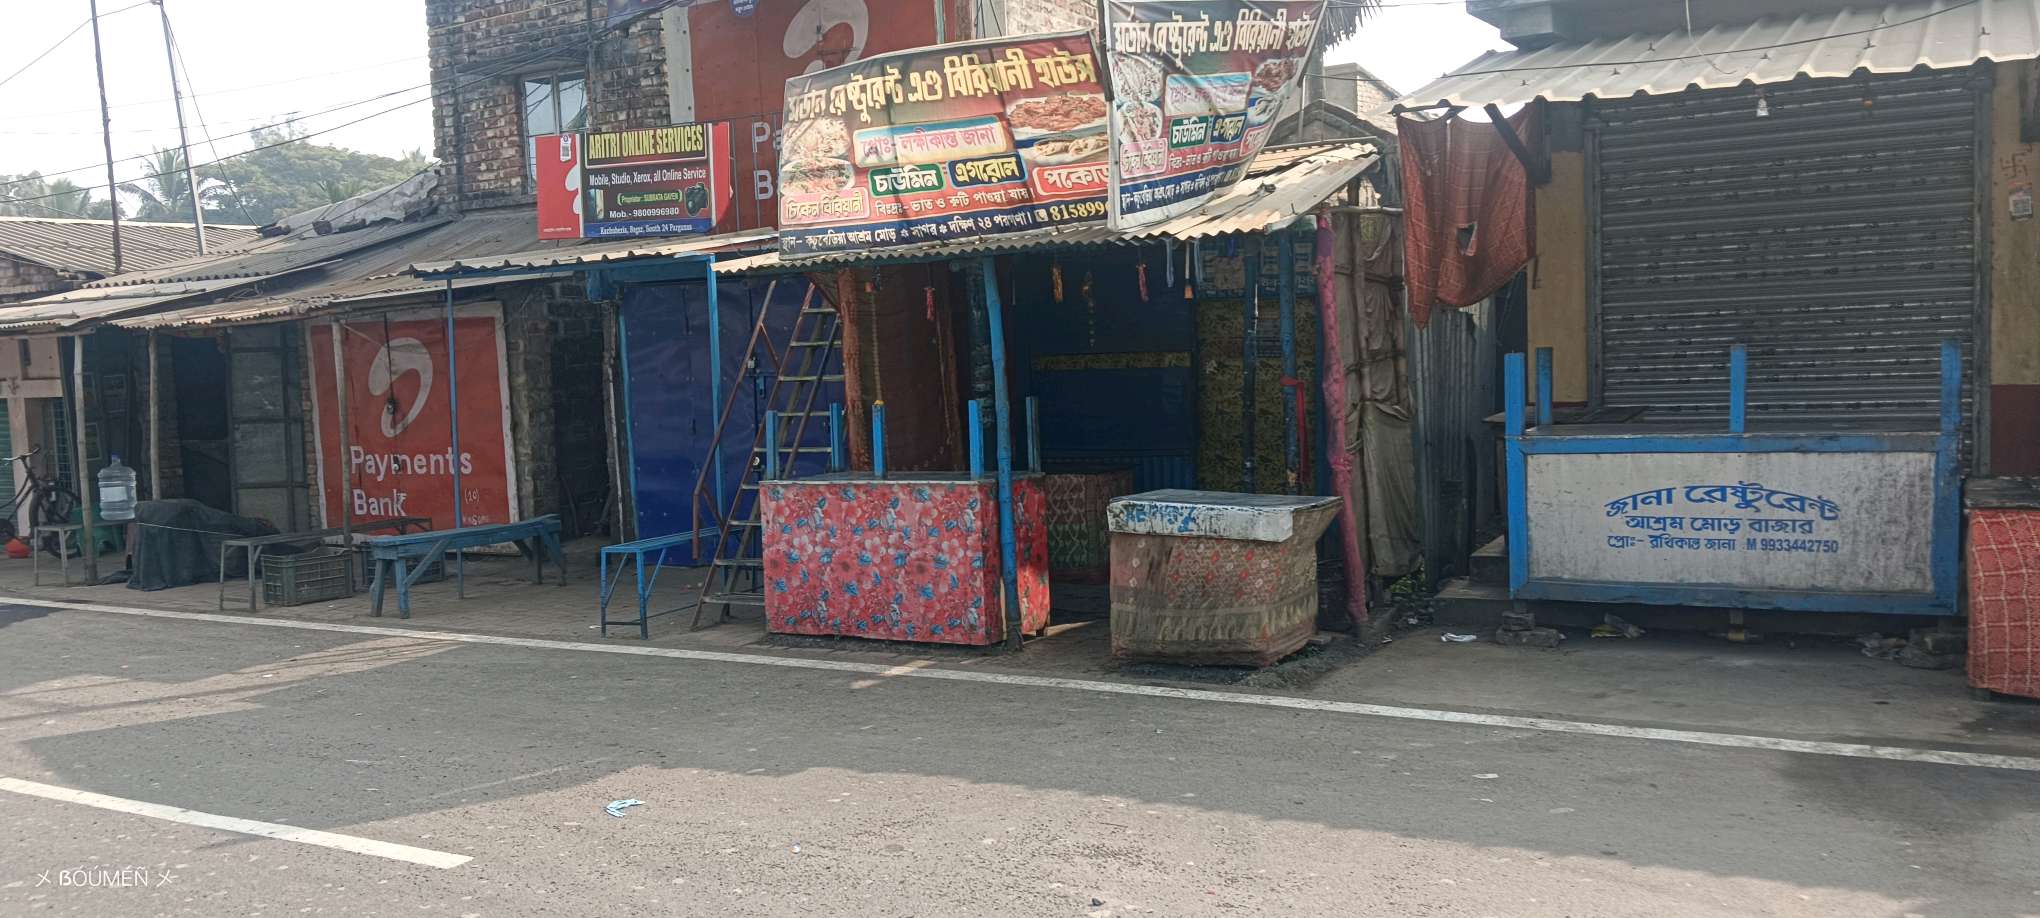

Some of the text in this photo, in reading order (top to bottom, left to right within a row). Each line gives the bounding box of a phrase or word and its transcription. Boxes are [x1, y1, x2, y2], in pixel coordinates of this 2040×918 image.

[1033, 47, 1097, 87] হাউস
[589, 125, 703, 159] ARITRI ONLINE SERVICES
[960, 125, 996, 147] জানা
[589, 167, 706, 187] Mobile, Studio, Xerox, all Online Service
[873, 165, 939, 192] চাউমিন
[955, 157, 1019, 183] এগরোল
[910, 199, 933, 213] ভাত
[936, 200, 947, 209] ও
[949, 192, 970, 207] রুটি
[874, 227, 897, 243] মোড়
[977, 217, 992, 230] ২৪
[351, 446, 472, 482] Payments
[353, 489, 407, 517] Bank
[1604, 480, 1841, 521] জানা রেষ্টুরেন্ট
[1624, 515, 1815, 534] আশ্রম মোড় বাজার
[1704, 537, 1736, 551] জানা
[1760, 538, 1840, 553] 9933442750
